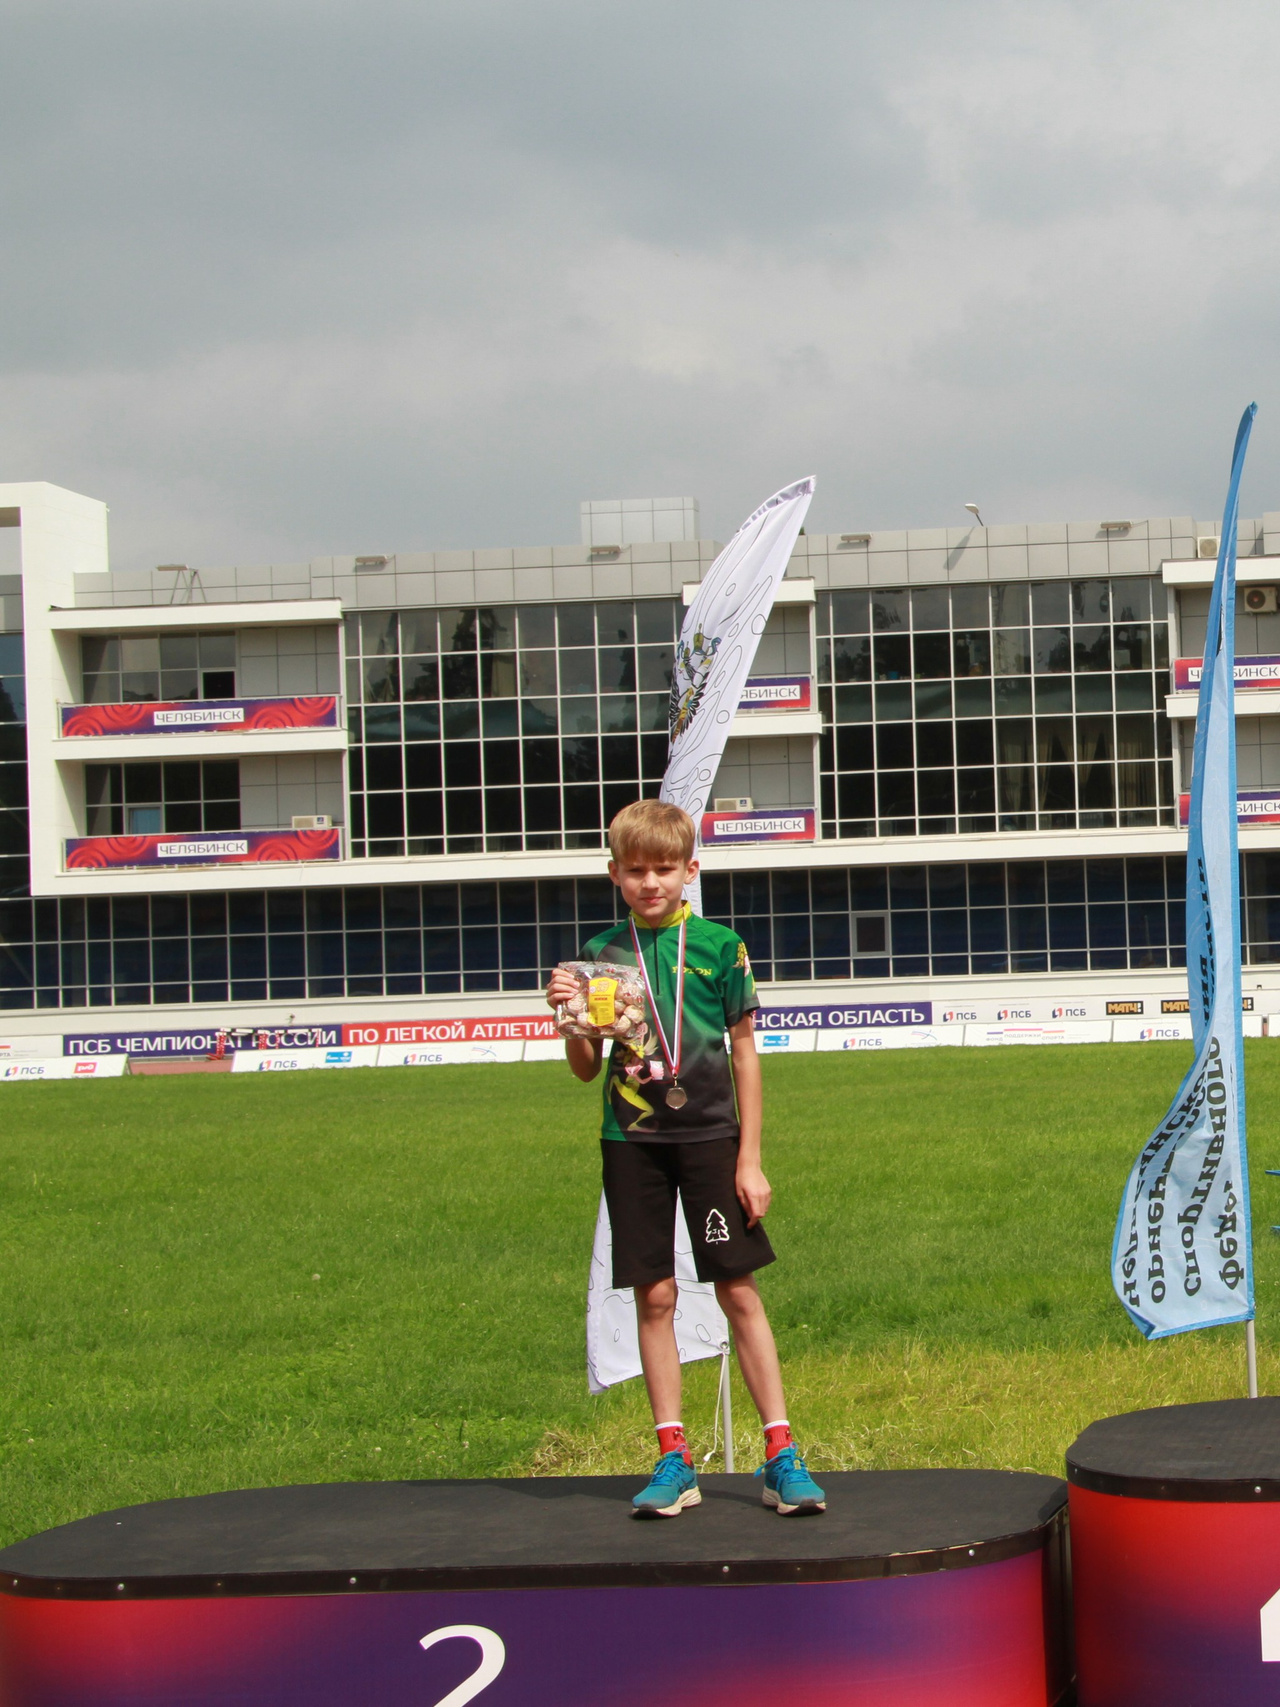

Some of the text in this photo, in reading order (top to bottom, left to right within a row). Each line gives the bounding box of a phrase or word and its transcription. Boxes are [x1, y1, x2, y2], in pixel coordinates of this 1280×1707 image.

[740, 687, 798, 700] ЯБИНСК
[156, 710, 243, 724] ЧЕЛЯБИНСК
[716, 819, 803, 833] ЧЕЛЯБИНСК
[160, 841, 246, 856] ЧЕЛЯБИНСК
[828, 1007, 926, 1026] ОБЛАСТЬ
[956, 1011, 977, 1020] ПСБ
[1010, 1010, 1032, 1019] ПСБ
[1065, 1008, 1087, 1017] ПСБ
[349, 1028, 379, 1044] ПО
[385, 1021, 466, 1042] ЛЕГКОЙ
[1156, 1029, 1180, 1038] ПСБ
[69, 1039, 112, 1055] ПСБ
[858, 1038, 882, 1047] ПСБ
[419, 1054, 443, 1063] ПСБ
[274, 1060, 298, 1069] ПСБ
[21, 1066, 45, 1075] ПСБ
[419, 1624, 506, 1707] 2
